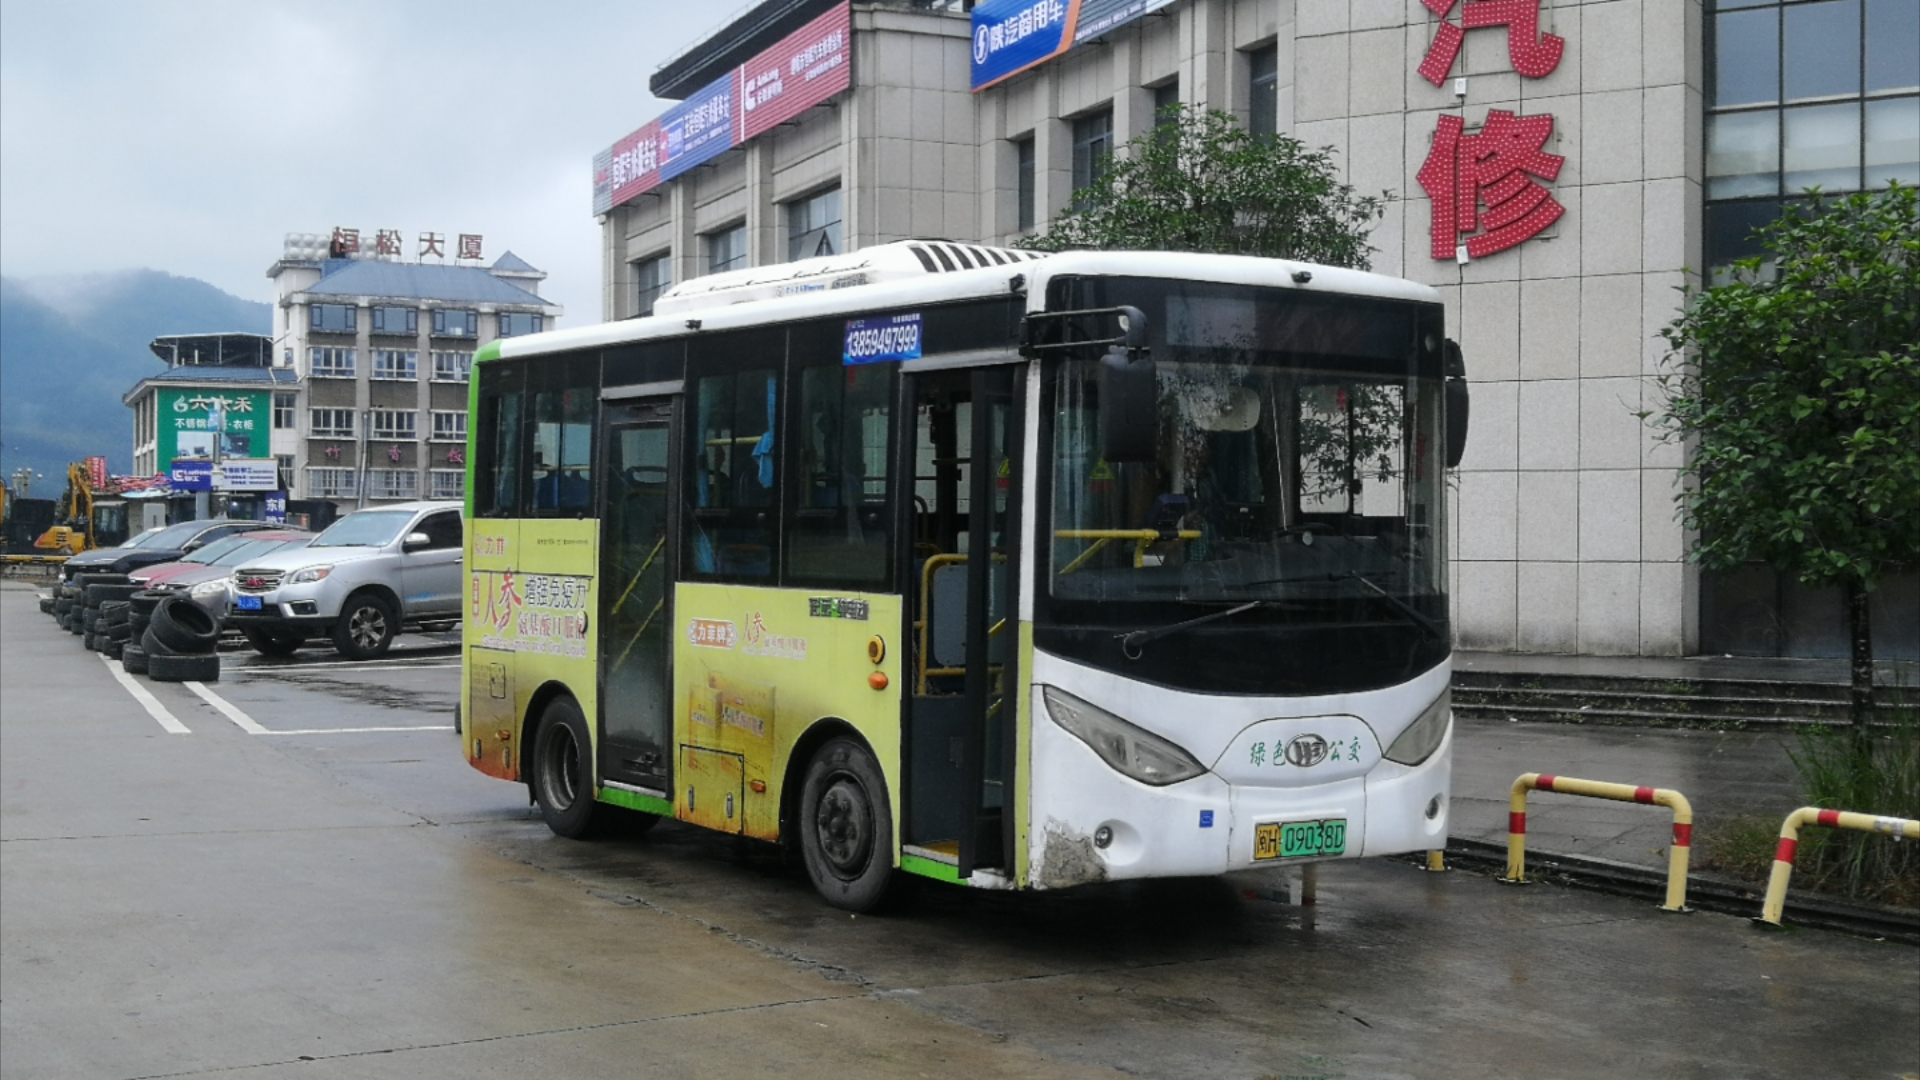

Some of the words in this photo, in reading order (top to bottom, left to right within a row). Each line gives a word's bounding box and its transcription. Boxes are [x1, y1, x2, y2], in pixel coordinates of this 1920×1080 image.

[989, 0, 1063, 53] 陕汽商用车
[332, 226, 484, 261] 恒松大厦
[847, 324, 918, 357] 13859497999
[174, 418, 253, 430] 不锈钢·衣柜
[525, 575, 587, 609] 增强免疫力
[1250, 740, 1286, 768] 绿色
